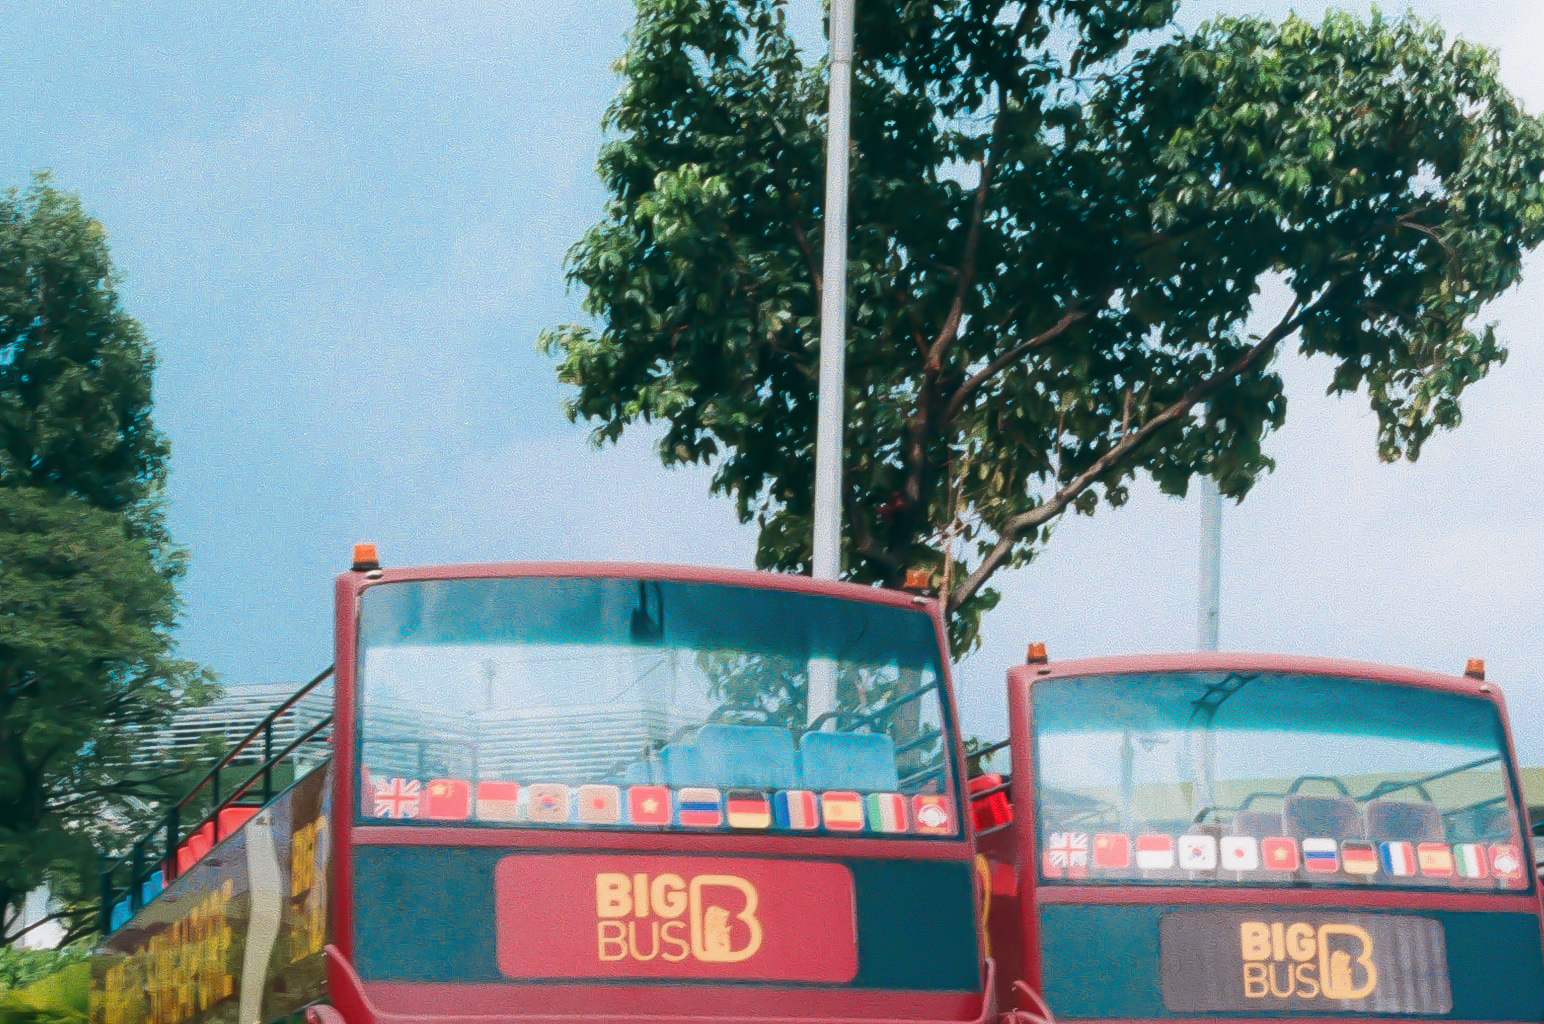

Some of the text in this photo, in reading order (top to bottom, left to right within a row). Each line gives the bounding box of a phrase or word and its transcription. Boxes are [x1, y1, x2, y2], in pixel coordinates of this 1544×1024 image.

[596, 872, 688, 918] BIG
[598, 920, 691, 962] BUS
[1240, 921, 1316, 962] BIG
[1243, 961, 1320, 998] BUS
